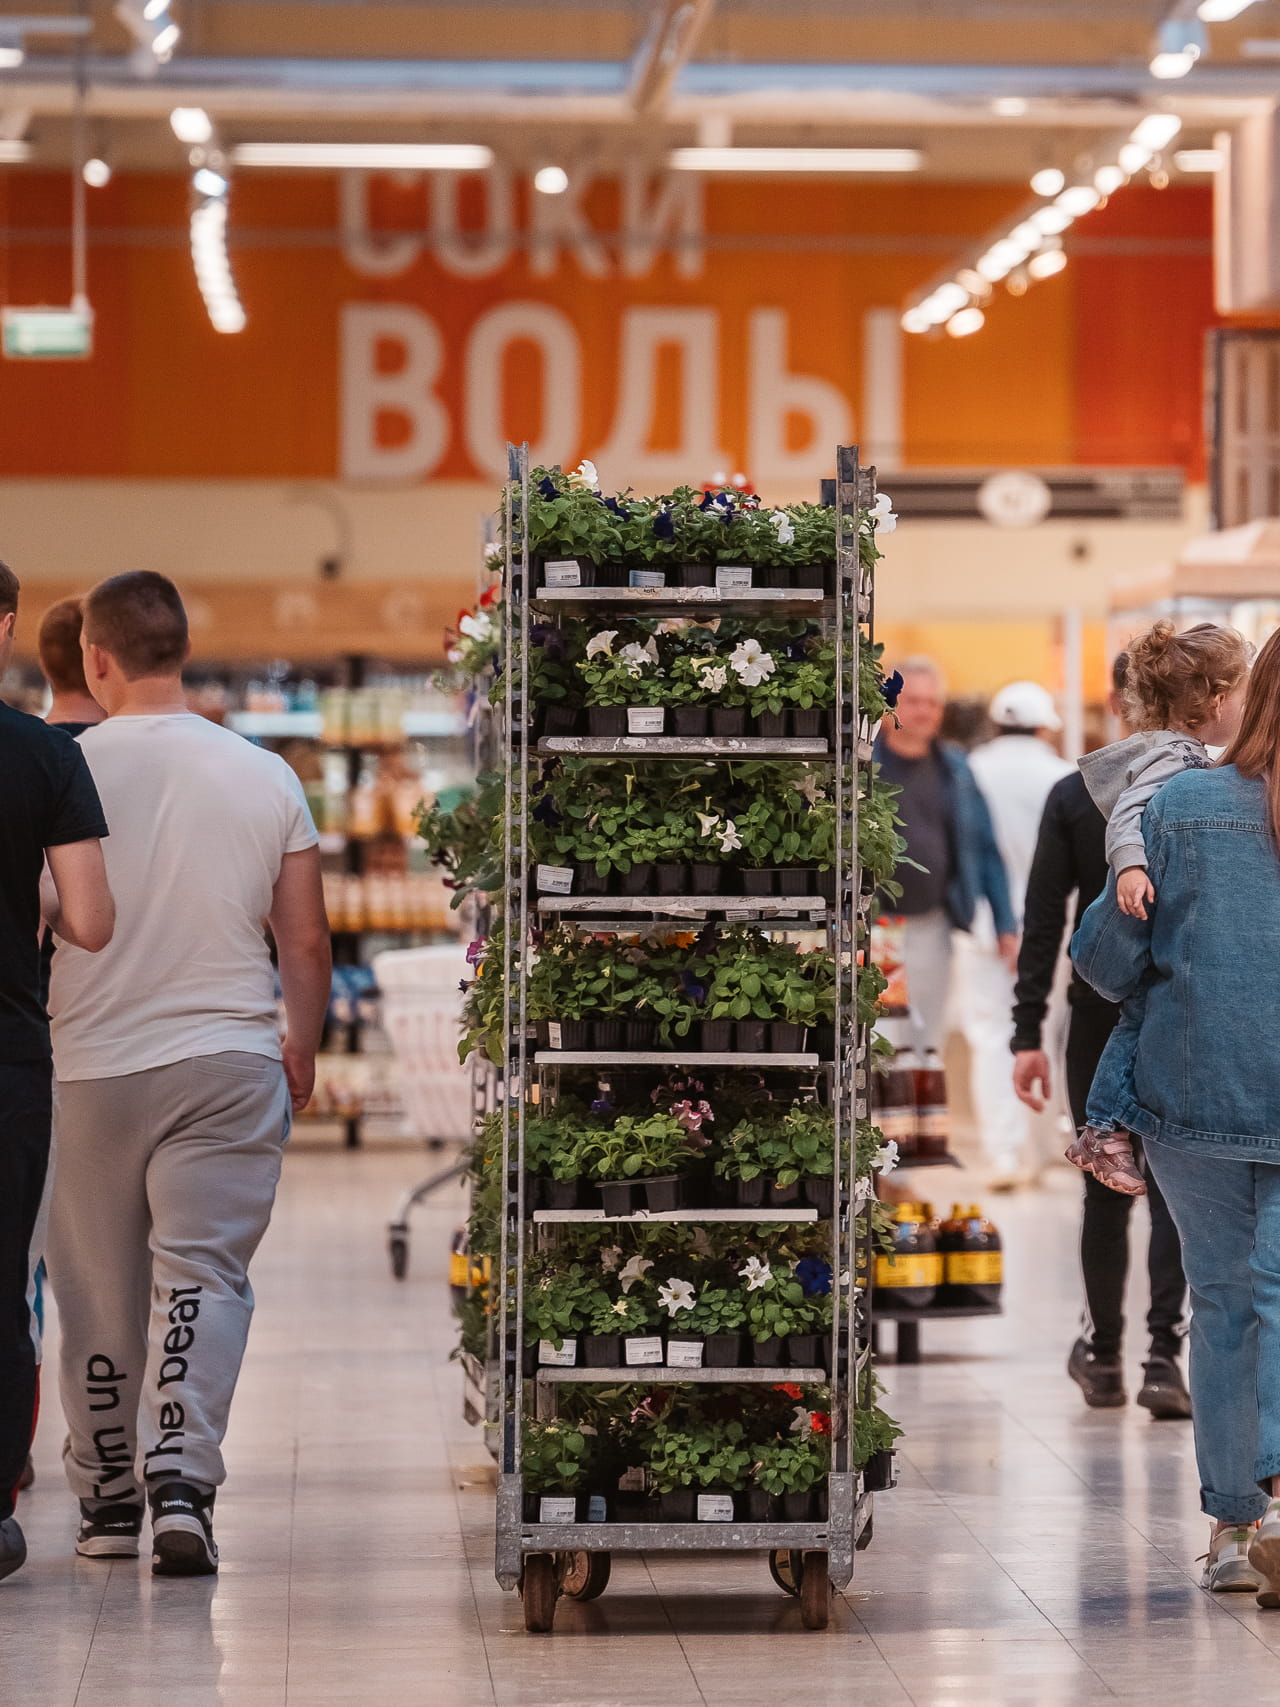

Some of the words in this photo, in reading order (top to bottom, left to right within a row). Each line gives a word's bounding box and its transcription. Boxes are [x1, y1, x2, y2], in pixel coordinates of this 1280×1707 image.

[341, 152, 706, 279] СОКИ
[338, 300, 904, 484] ВОДЫ
[87, 1353, 127, 1411] up
